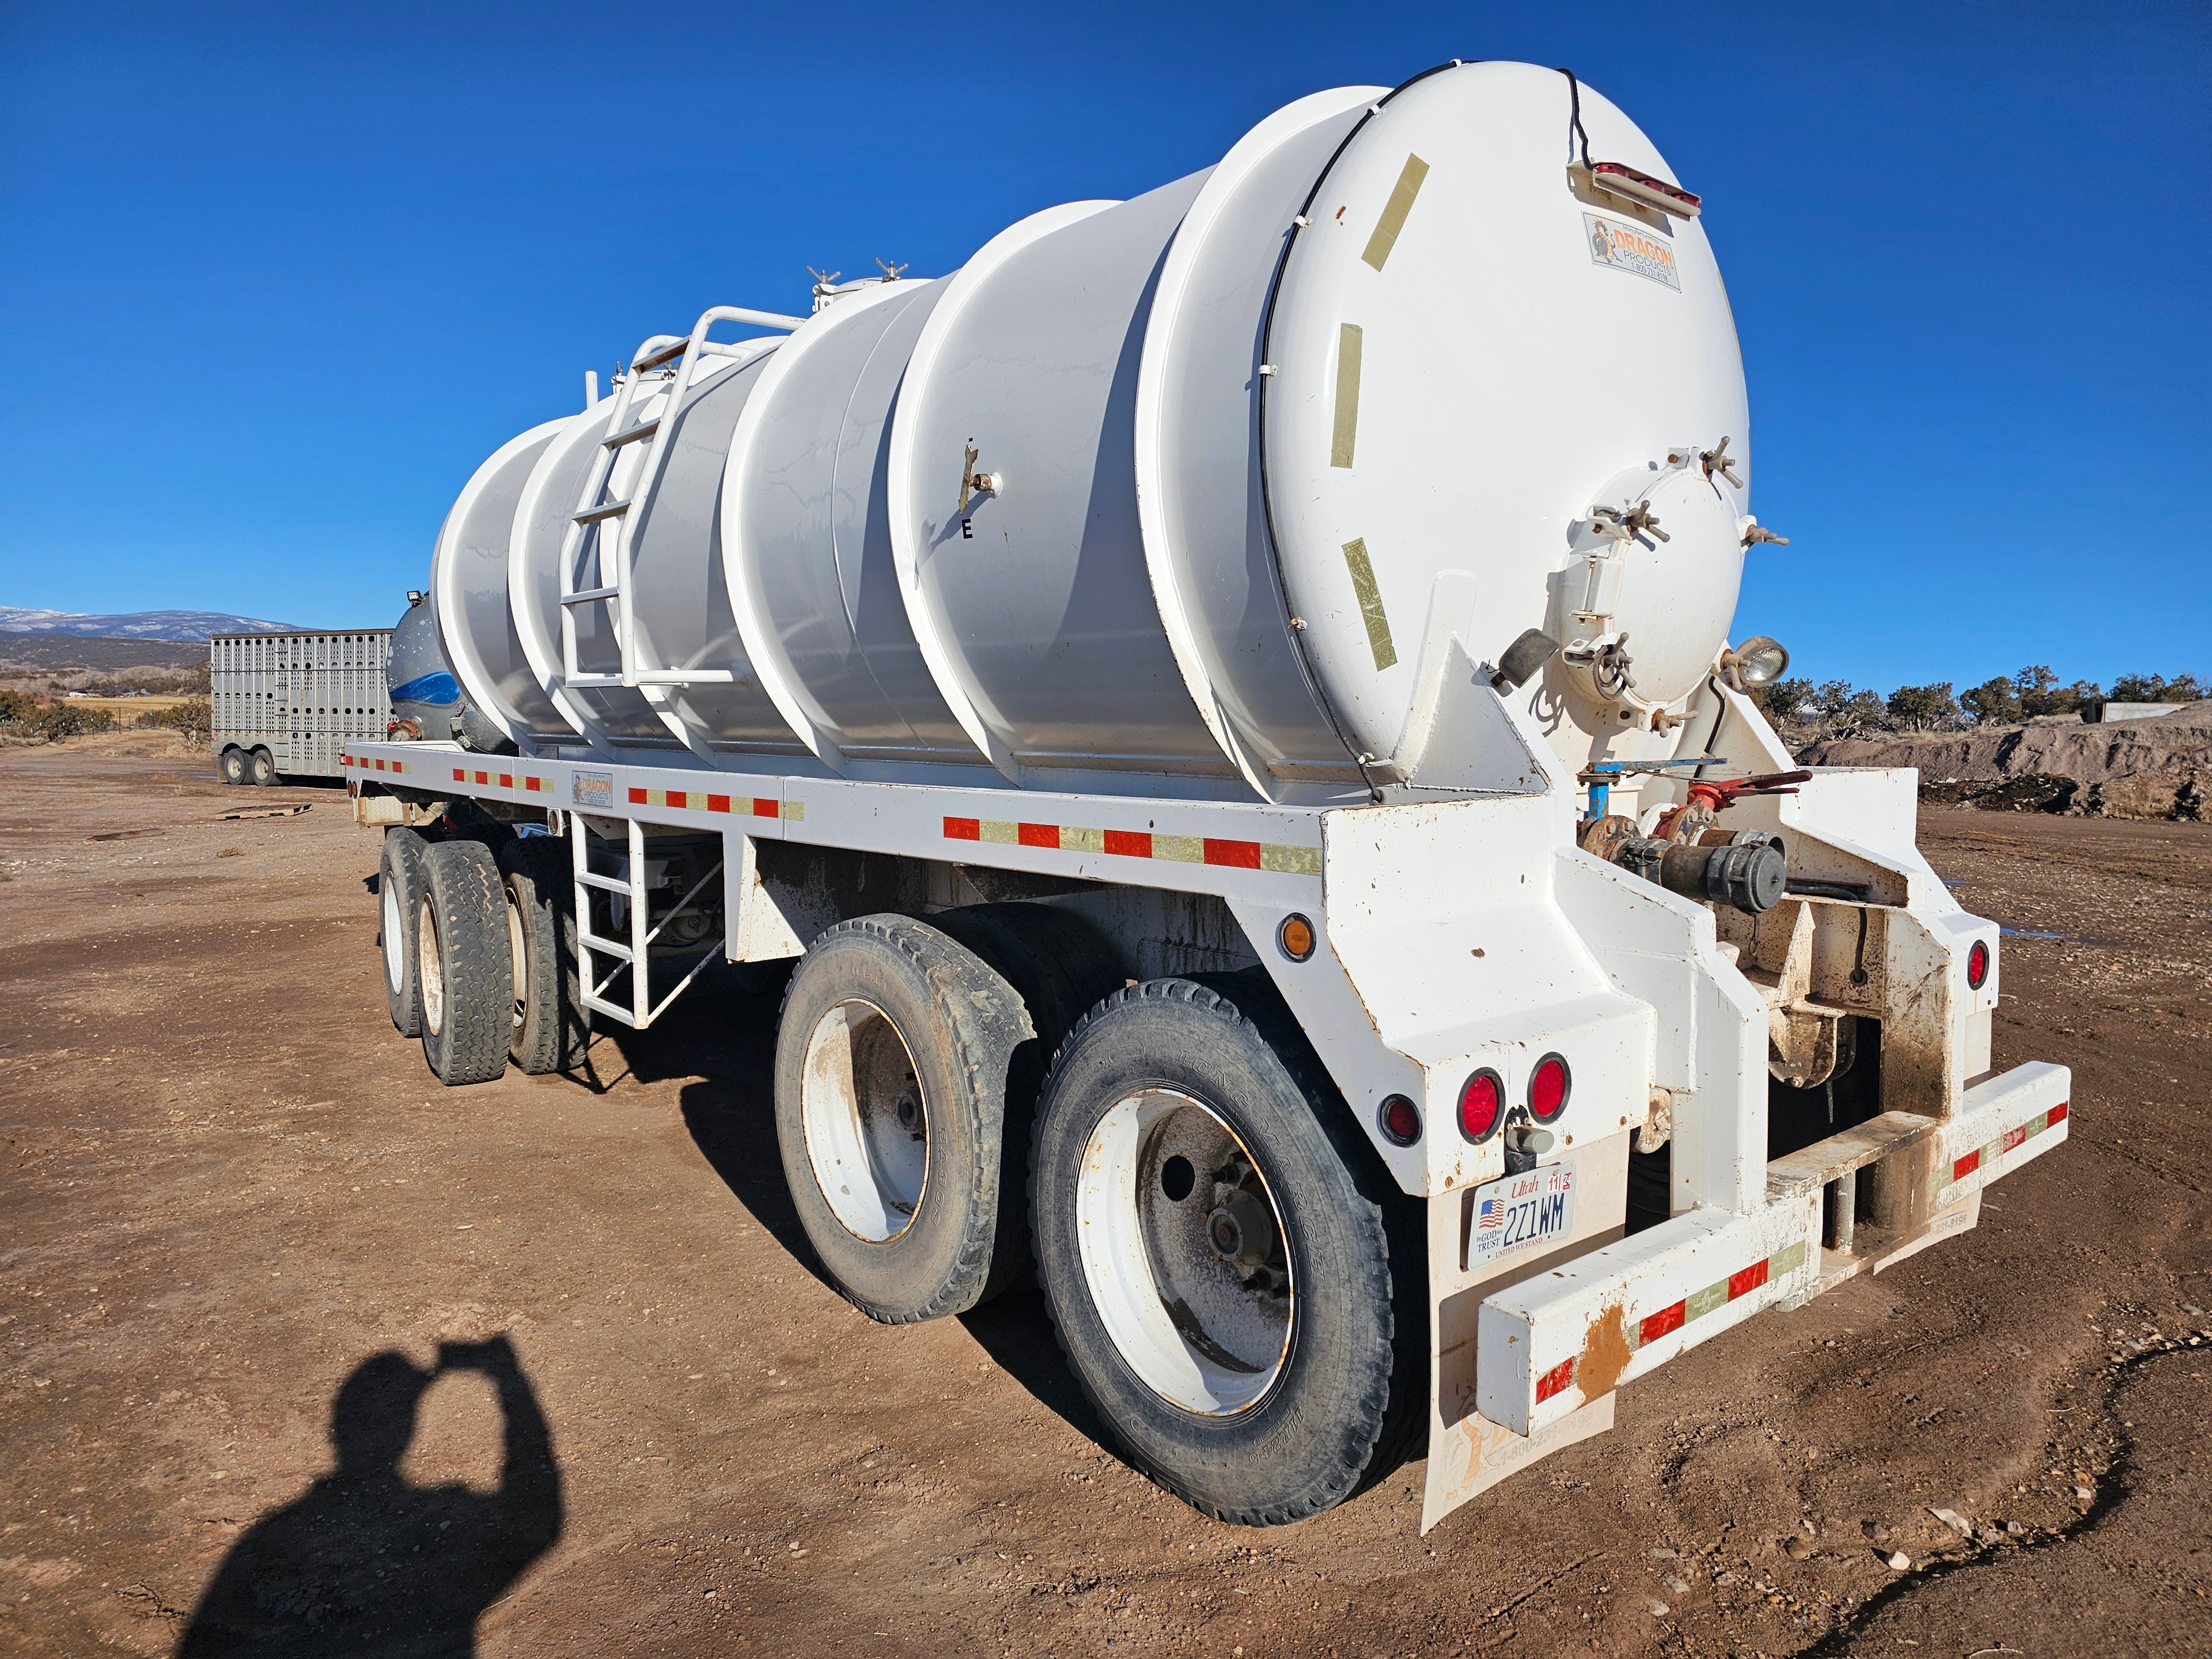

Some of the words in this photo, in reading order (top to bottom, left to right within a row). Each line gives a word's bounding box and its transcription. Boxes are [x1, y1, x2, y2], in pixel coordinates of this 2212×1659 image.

[1613, 229, 1673, 270] DRAGON
[1623, 250, 1671, 276] PRODUCTS
[1631, 262, 1668, 282] 1-800-231-8198
[961, 518, 973, 539] E
[582, 778, 611, 793] DRAGON
[585, 791, 608, 800] PRODUCTS
[1175, 1049, 1252, 1111] LONG
[1252, 1117, 1326, 1283] MARCH
[1512, 1175, 1539, 1199] Utah
[1548, 1176, 1558, 1191] 11
[1563, 1175, 1571, 1185] 24
[1503, 1192, 1565, 1247] 2Z1WM
[1478, 1238, 1500, 1252] TRUST
[1482, 1230, 1497, 1242] GOD
[1495, 1246, 1515, 1258] UNITED
[1525, 1237, 1543, 1248] STAND
